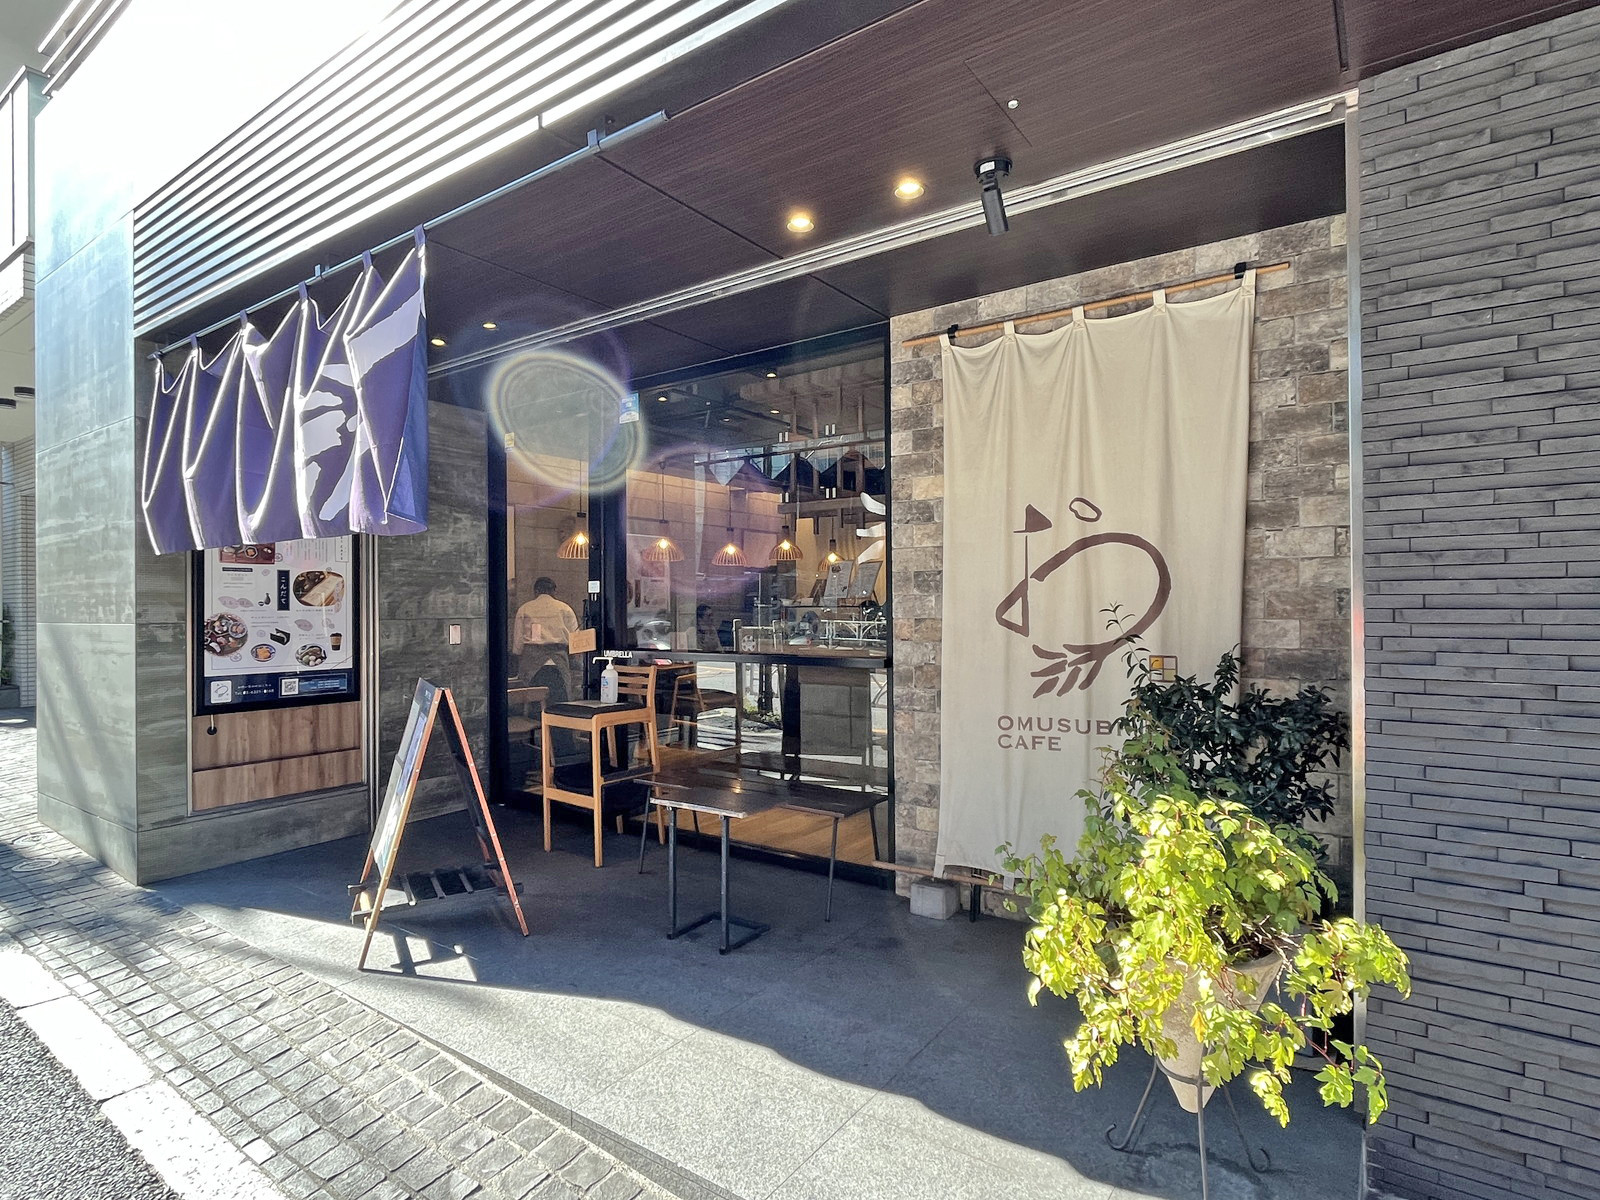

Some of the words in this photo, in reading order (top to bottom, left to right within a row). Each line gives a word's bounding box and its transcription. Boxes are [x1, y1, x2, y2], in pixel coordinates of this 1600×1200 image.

[280, 576, 288, 605] こんだて
[997, 733, 1062, 751] CAFE
